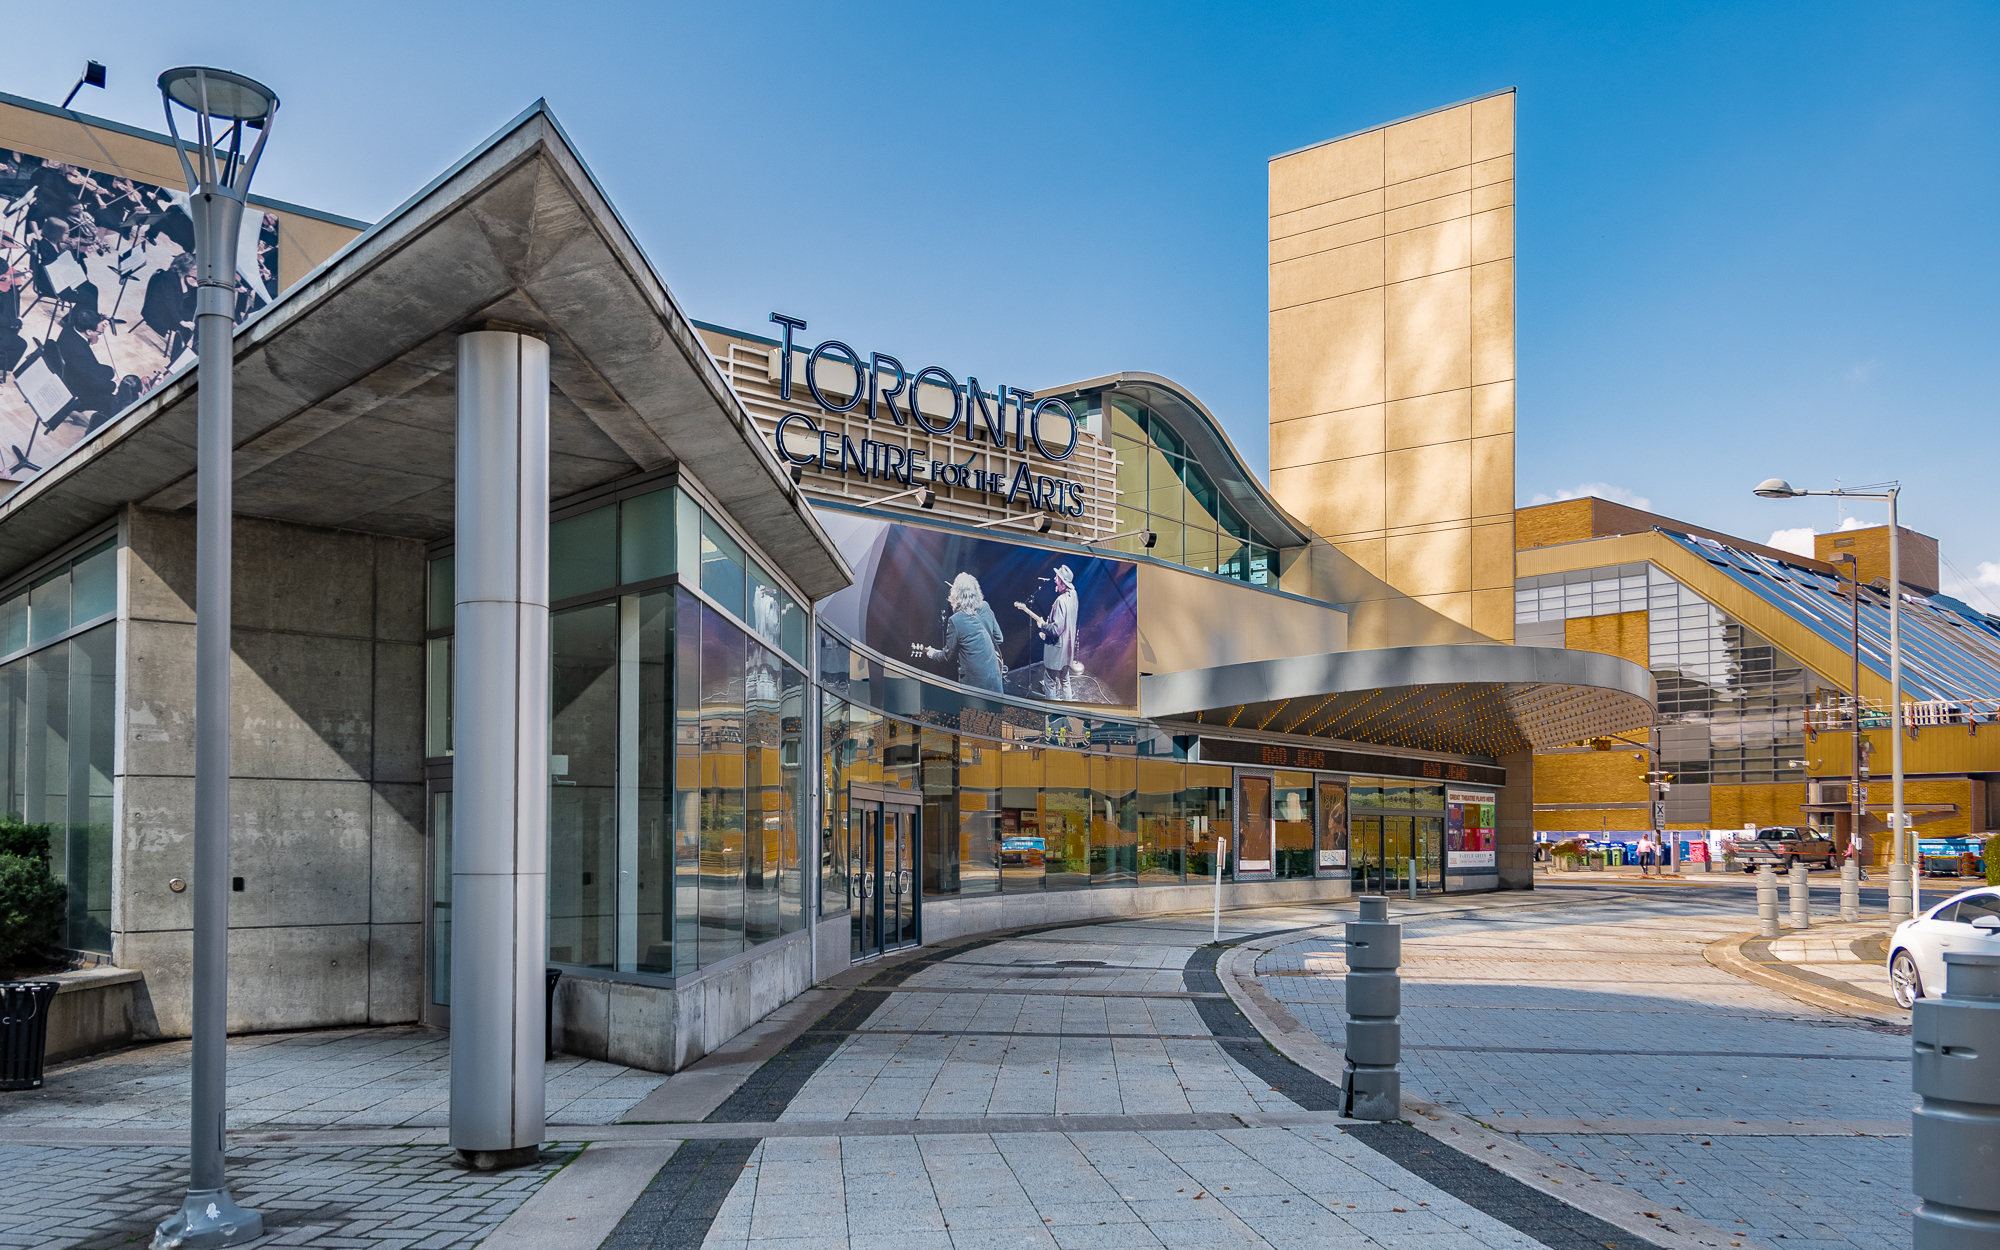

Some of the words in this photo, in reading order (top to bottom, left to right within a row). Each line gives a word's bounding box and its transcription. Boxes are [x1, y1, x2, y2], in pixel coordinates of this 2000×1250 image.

[768, 311, 1080, 461] TORONTO
[775, 412, 927, 487] CENTRE
[931, 460, 971, 488] FOR
[973, 468, 1006, 495] THE
[1006, 461, 1085, 518] ARTS
[1262, 746, 1287, 765] BAD
[1293, 749, 1325, 768] JEWS
[1423, 761, 1441, 778] BAD
[1445, 764, 1468, 780] JEWS
[1461, 794, 1476, 802] THEATRE
[1321, 851, 1345, 861] SEASON
